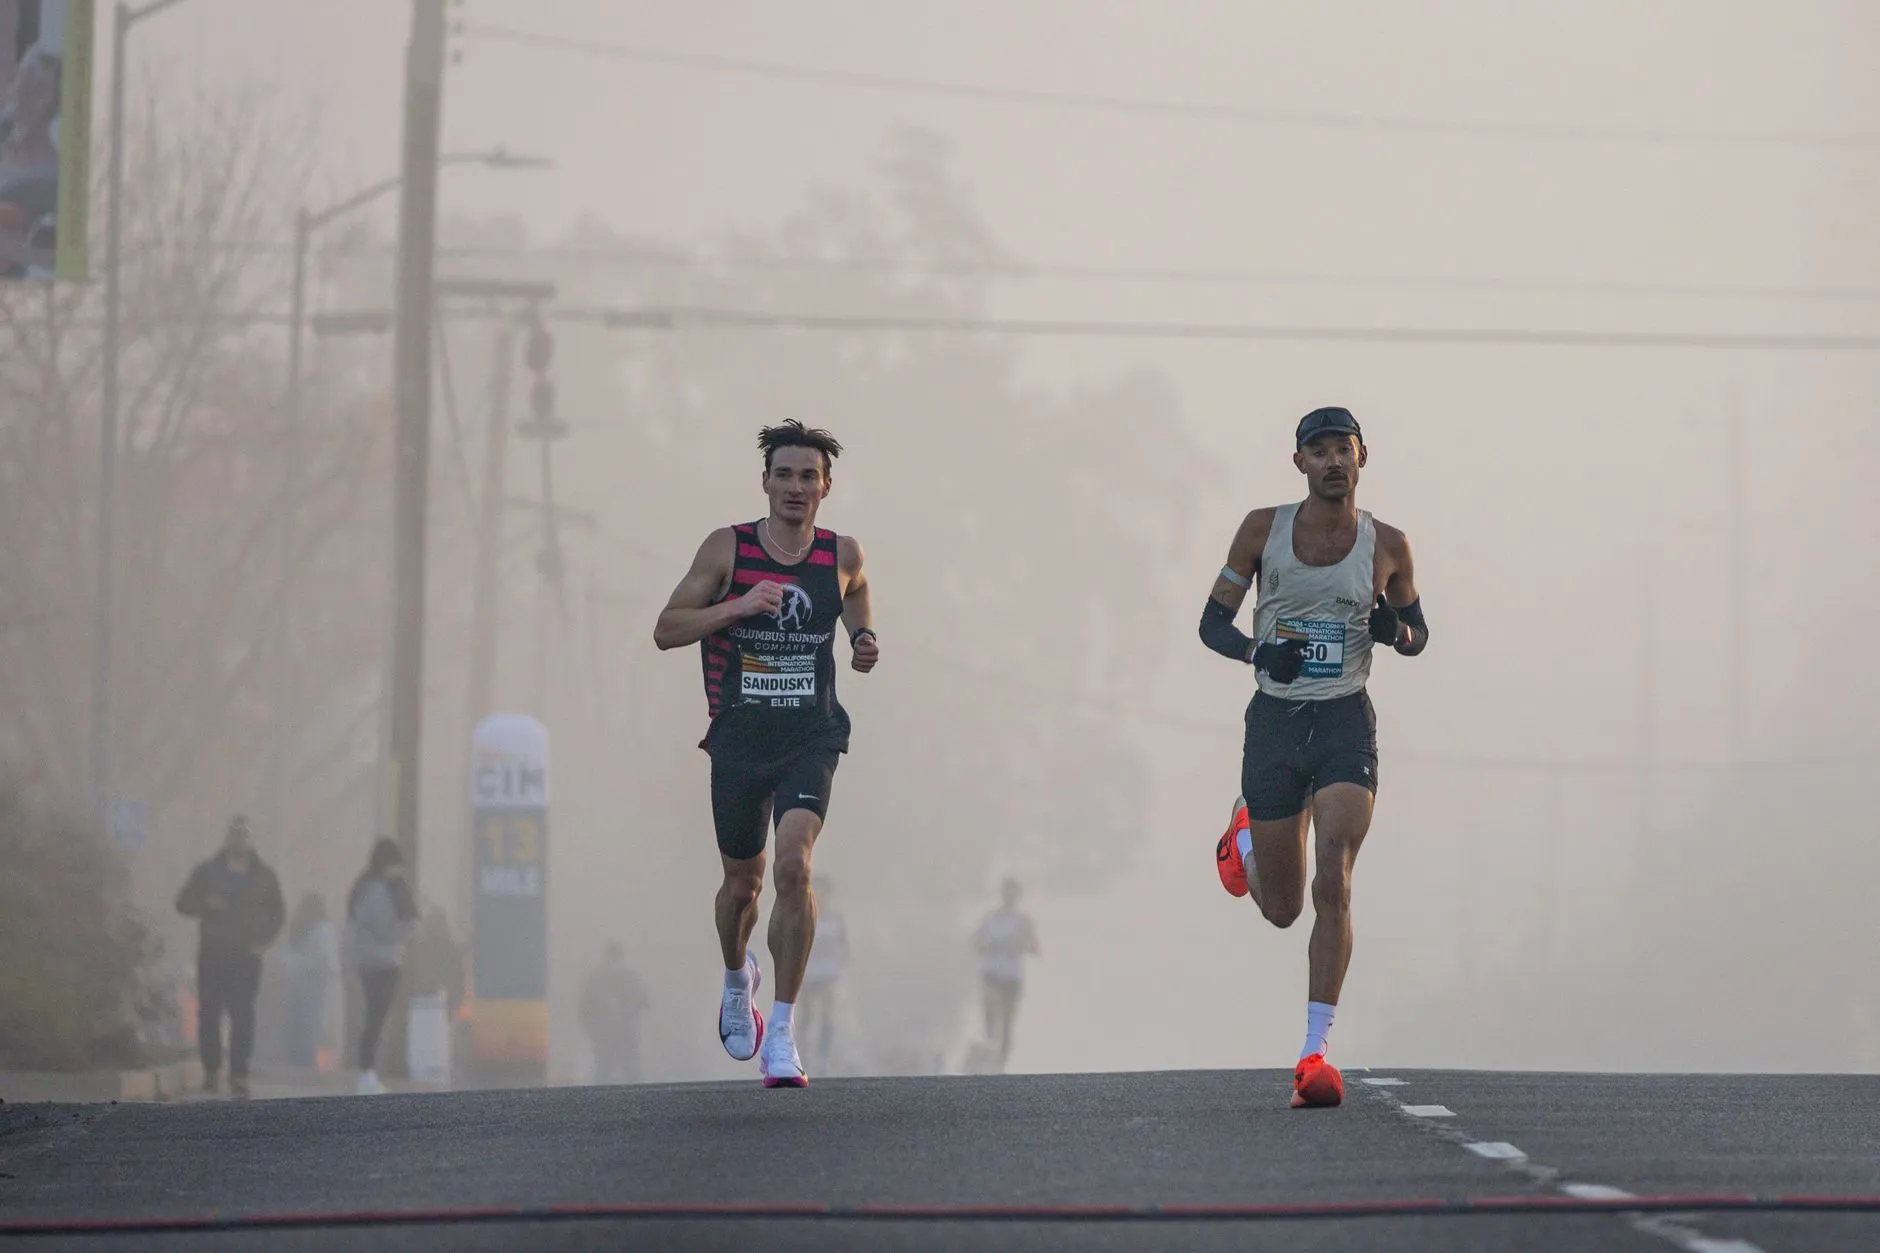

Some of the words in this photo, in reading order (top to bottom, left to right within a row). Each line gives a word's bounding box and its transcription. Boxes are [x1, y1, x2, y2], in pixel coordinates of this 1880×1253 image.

[729, 627, 785, 642] COLUMBUS
[1296, 627, 1344, 635] INTERNATIONAL
[754, 642, 806, 652] COMPANY
[743, 676, 814, 691] SANDUSKY
[771, 697, 801, 707] ELITE
[475, 764, 544, 799] CIM
[485, 819, 538, 862] 13
